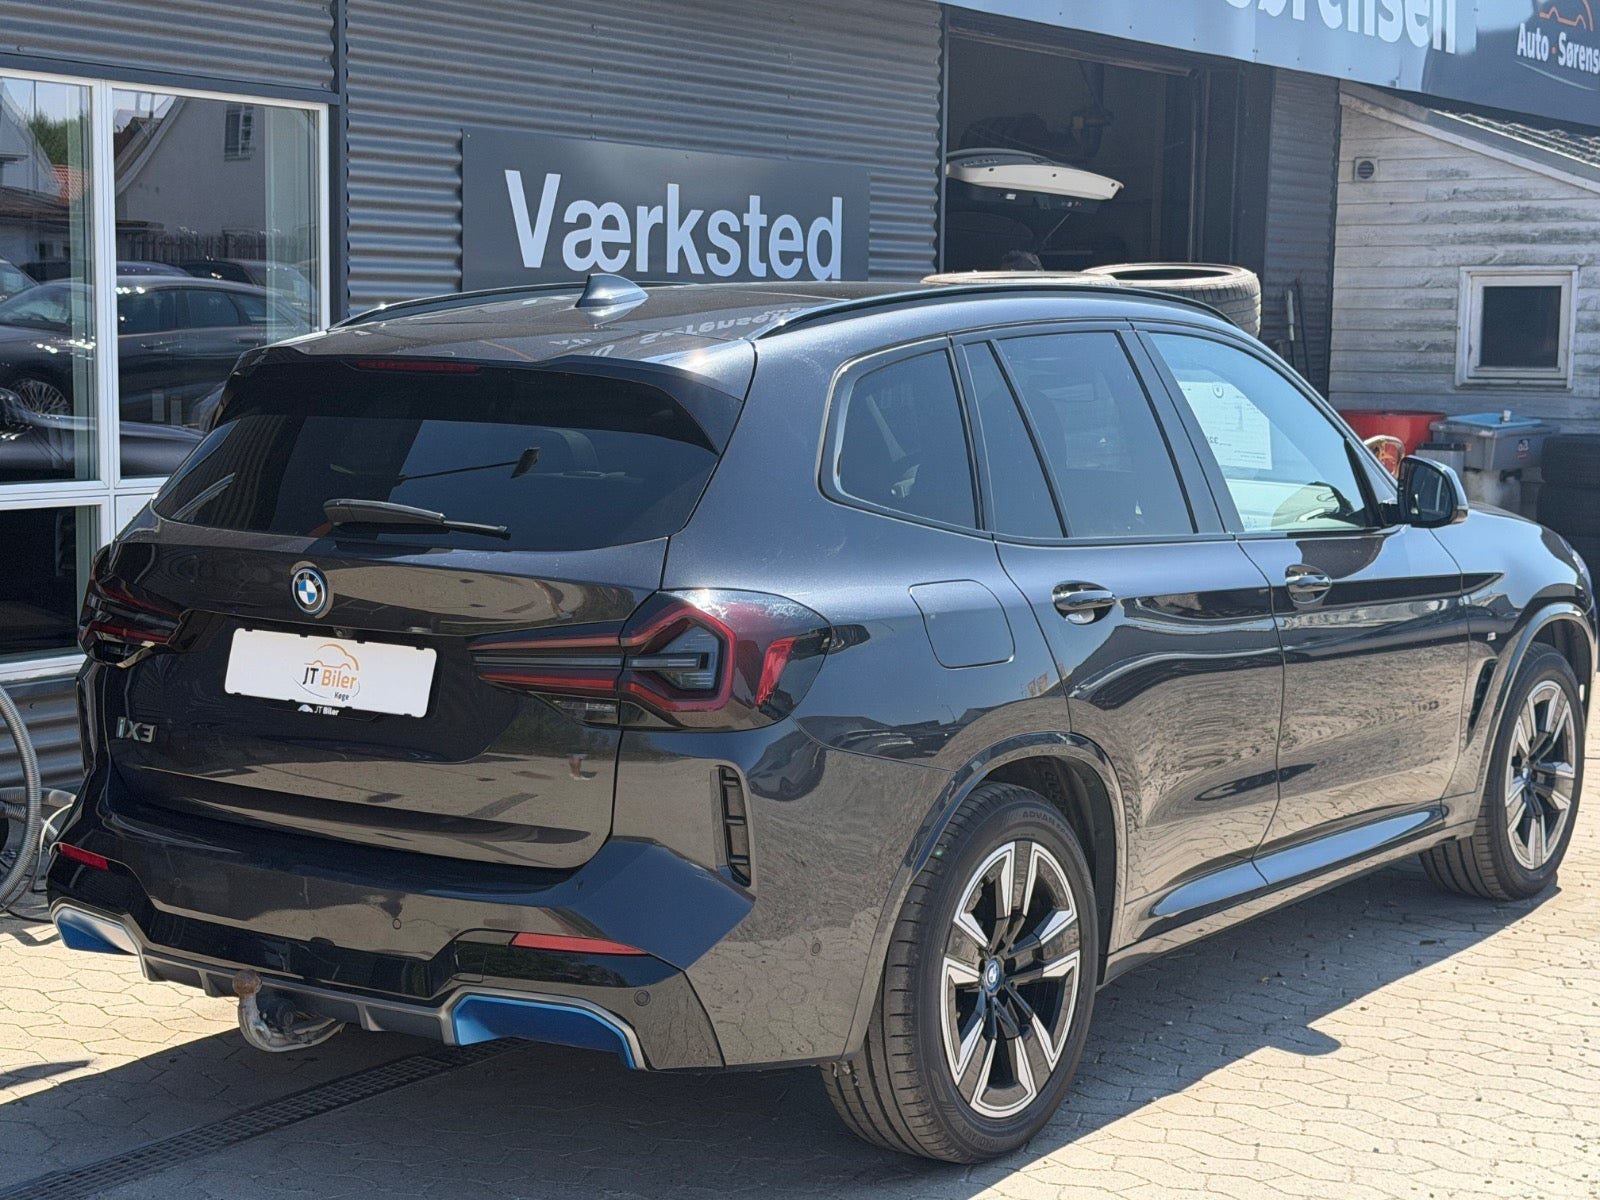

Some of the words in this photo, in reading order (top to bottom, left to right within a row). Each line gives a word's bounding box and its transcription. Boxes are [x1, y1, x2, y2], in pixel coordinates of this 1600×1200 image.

[1517, 22, 1550, 62] Auto
[1558, 31, 1600, 74] Sørens
[504, 169, 843, 281] Værksted
[302, 667, 320, 685] JT
[321, 669, 358, 689] Biler
[323, 706, 340, 716] Biler
